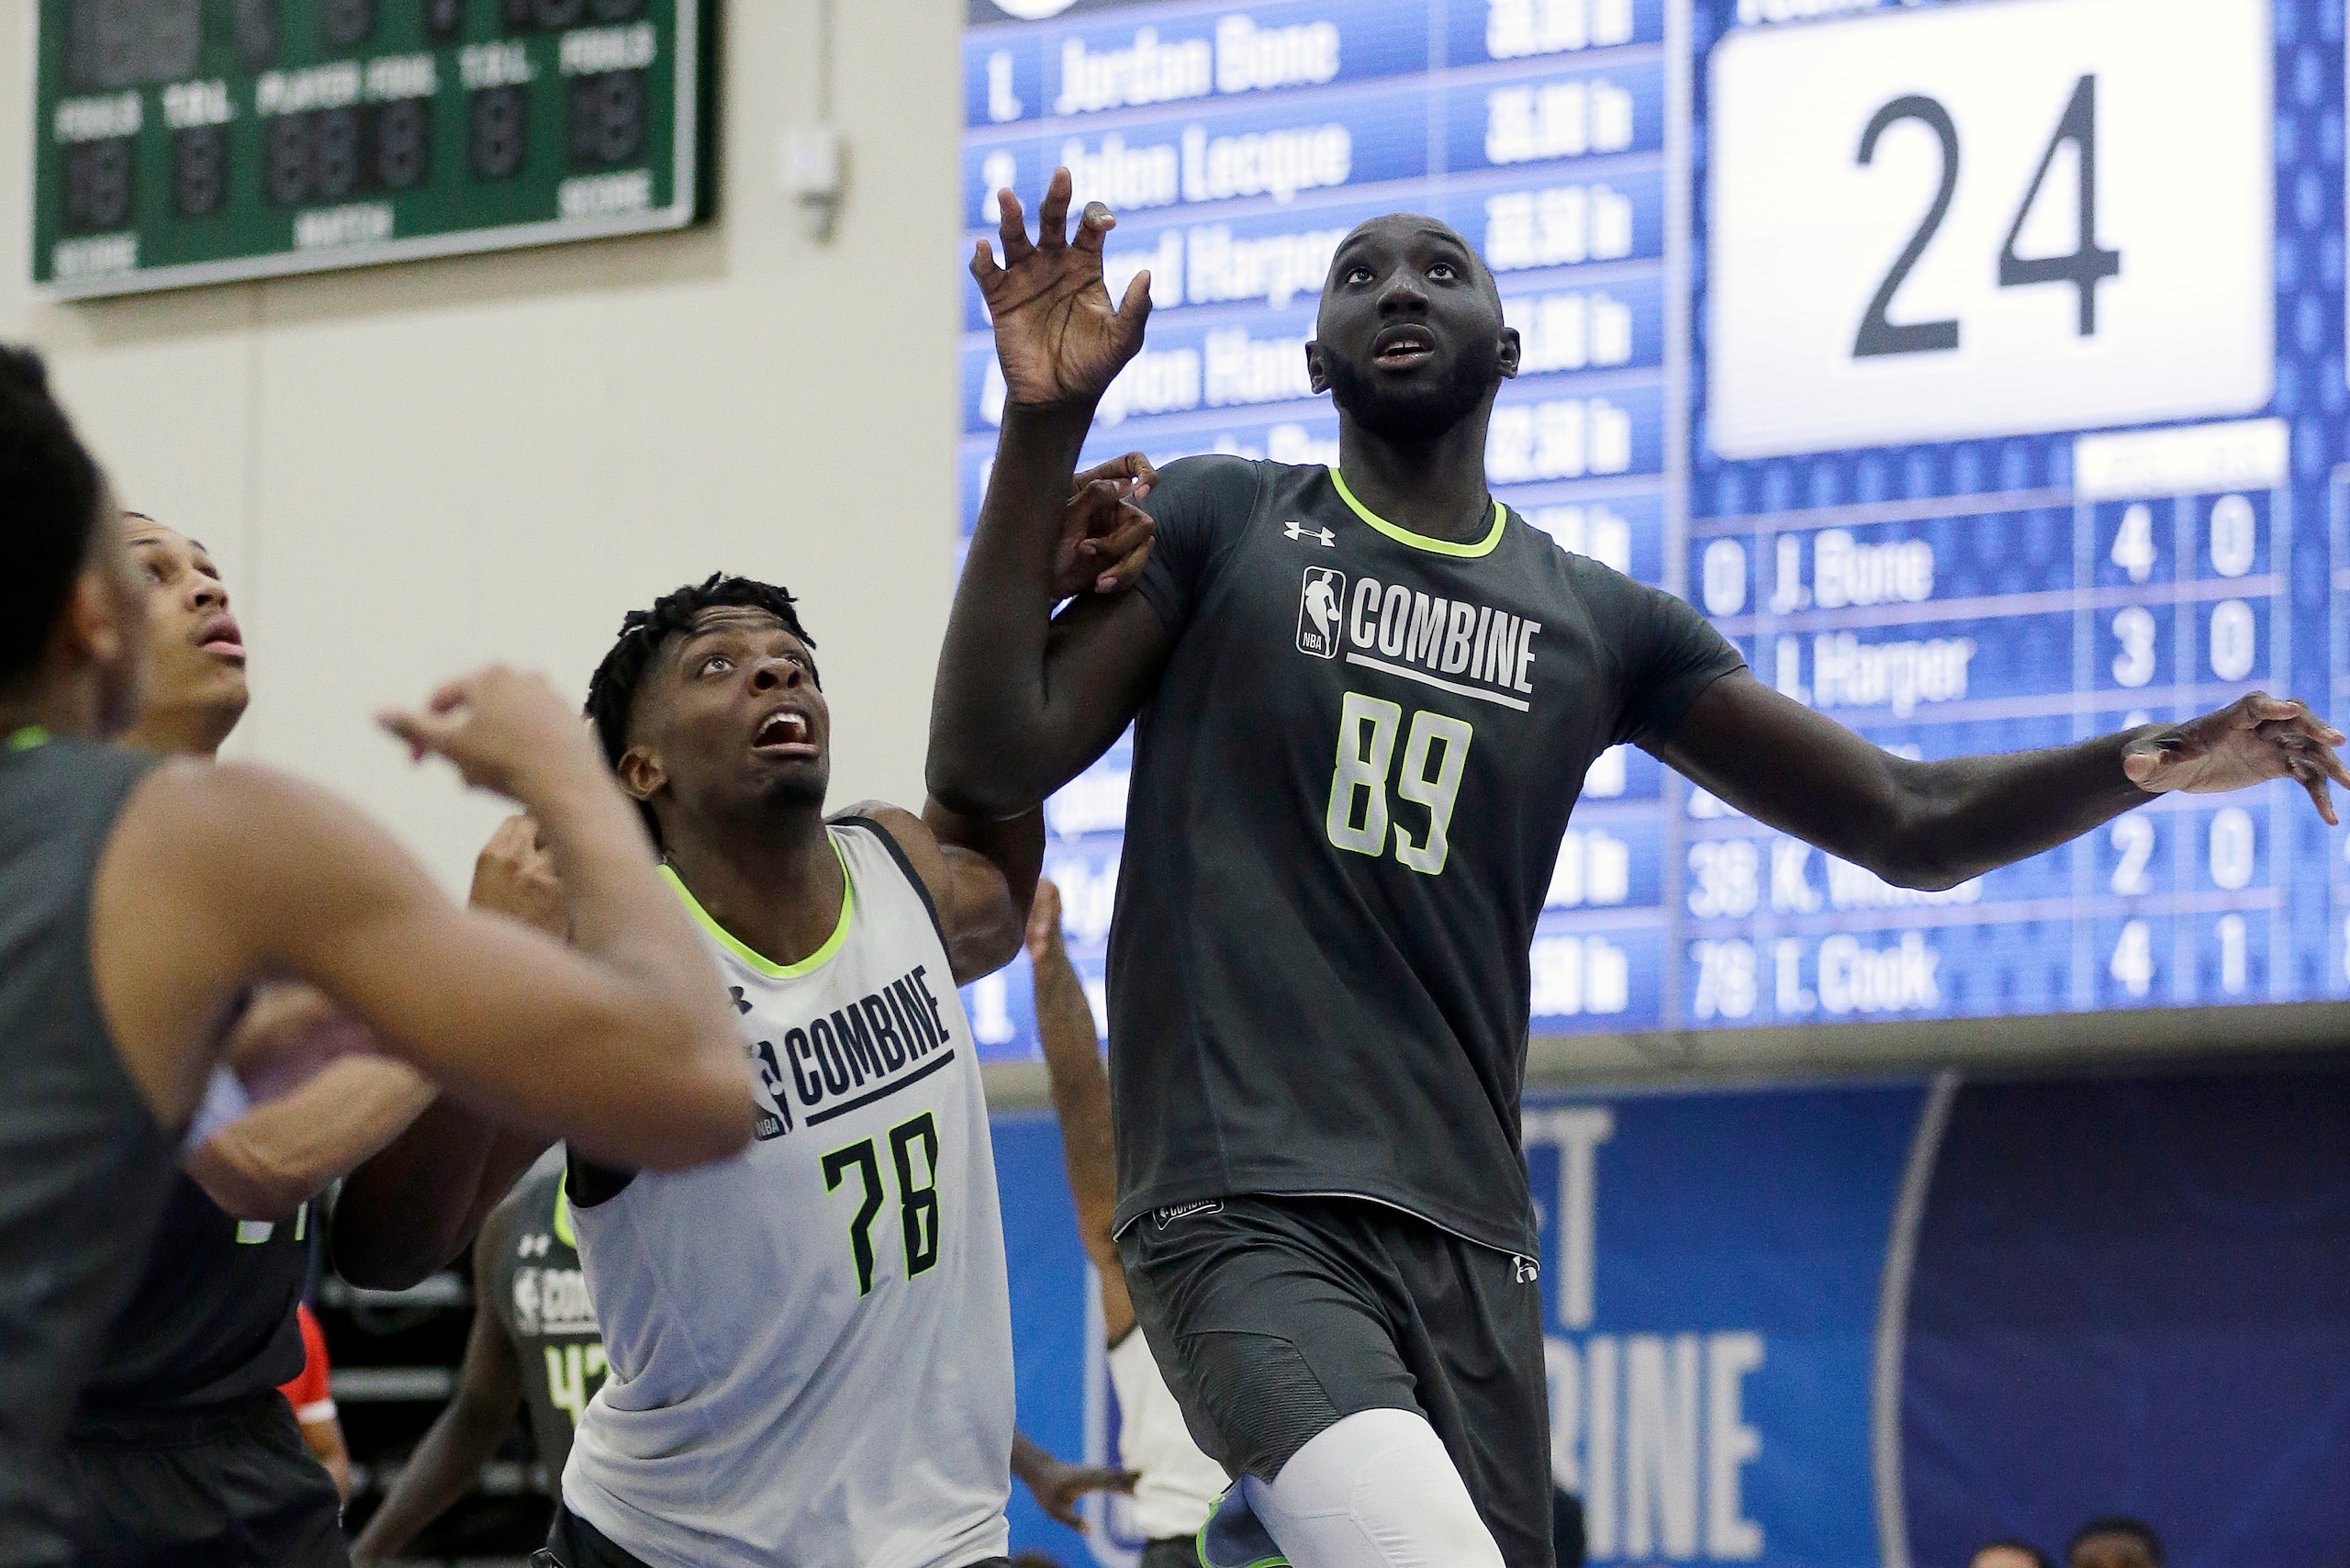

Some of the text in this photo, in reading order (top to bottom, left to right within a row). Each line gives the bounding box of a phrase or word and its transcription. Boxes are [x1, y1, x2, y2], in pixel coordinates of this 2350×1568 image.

[1055, 28, 1213, 115] Jordan
[1215, 14, 1340, 91] Bone
[1852, 73, 2121, 358] 24
[1703, 537, 1746, 617] 0
[1814, 528, 1934, 610] Bone
[2111, 502, 2154, 583] 4
[2210, 494, 2255, 577] 0
[1303, 577, 1541, 694] NBA COMBINE
[1814, 629, 1975, 719] Harper
[2112, 605, 2154, 688] 3
[2210, 599, 2255, 682] 0
[1327, 691, 1472, 876] 89
[2111, 815, 2154, 897] 2
[2210, 809, 2255, 890] 0
[1818, 930, 1940, 1014] Cook
[2111, 920, 2154, 999] 4
[2216, 913, 2247, 996] 1
[785, 965, 950, 1105] COMBINE
[819, 1111, 939, 1298] 78
